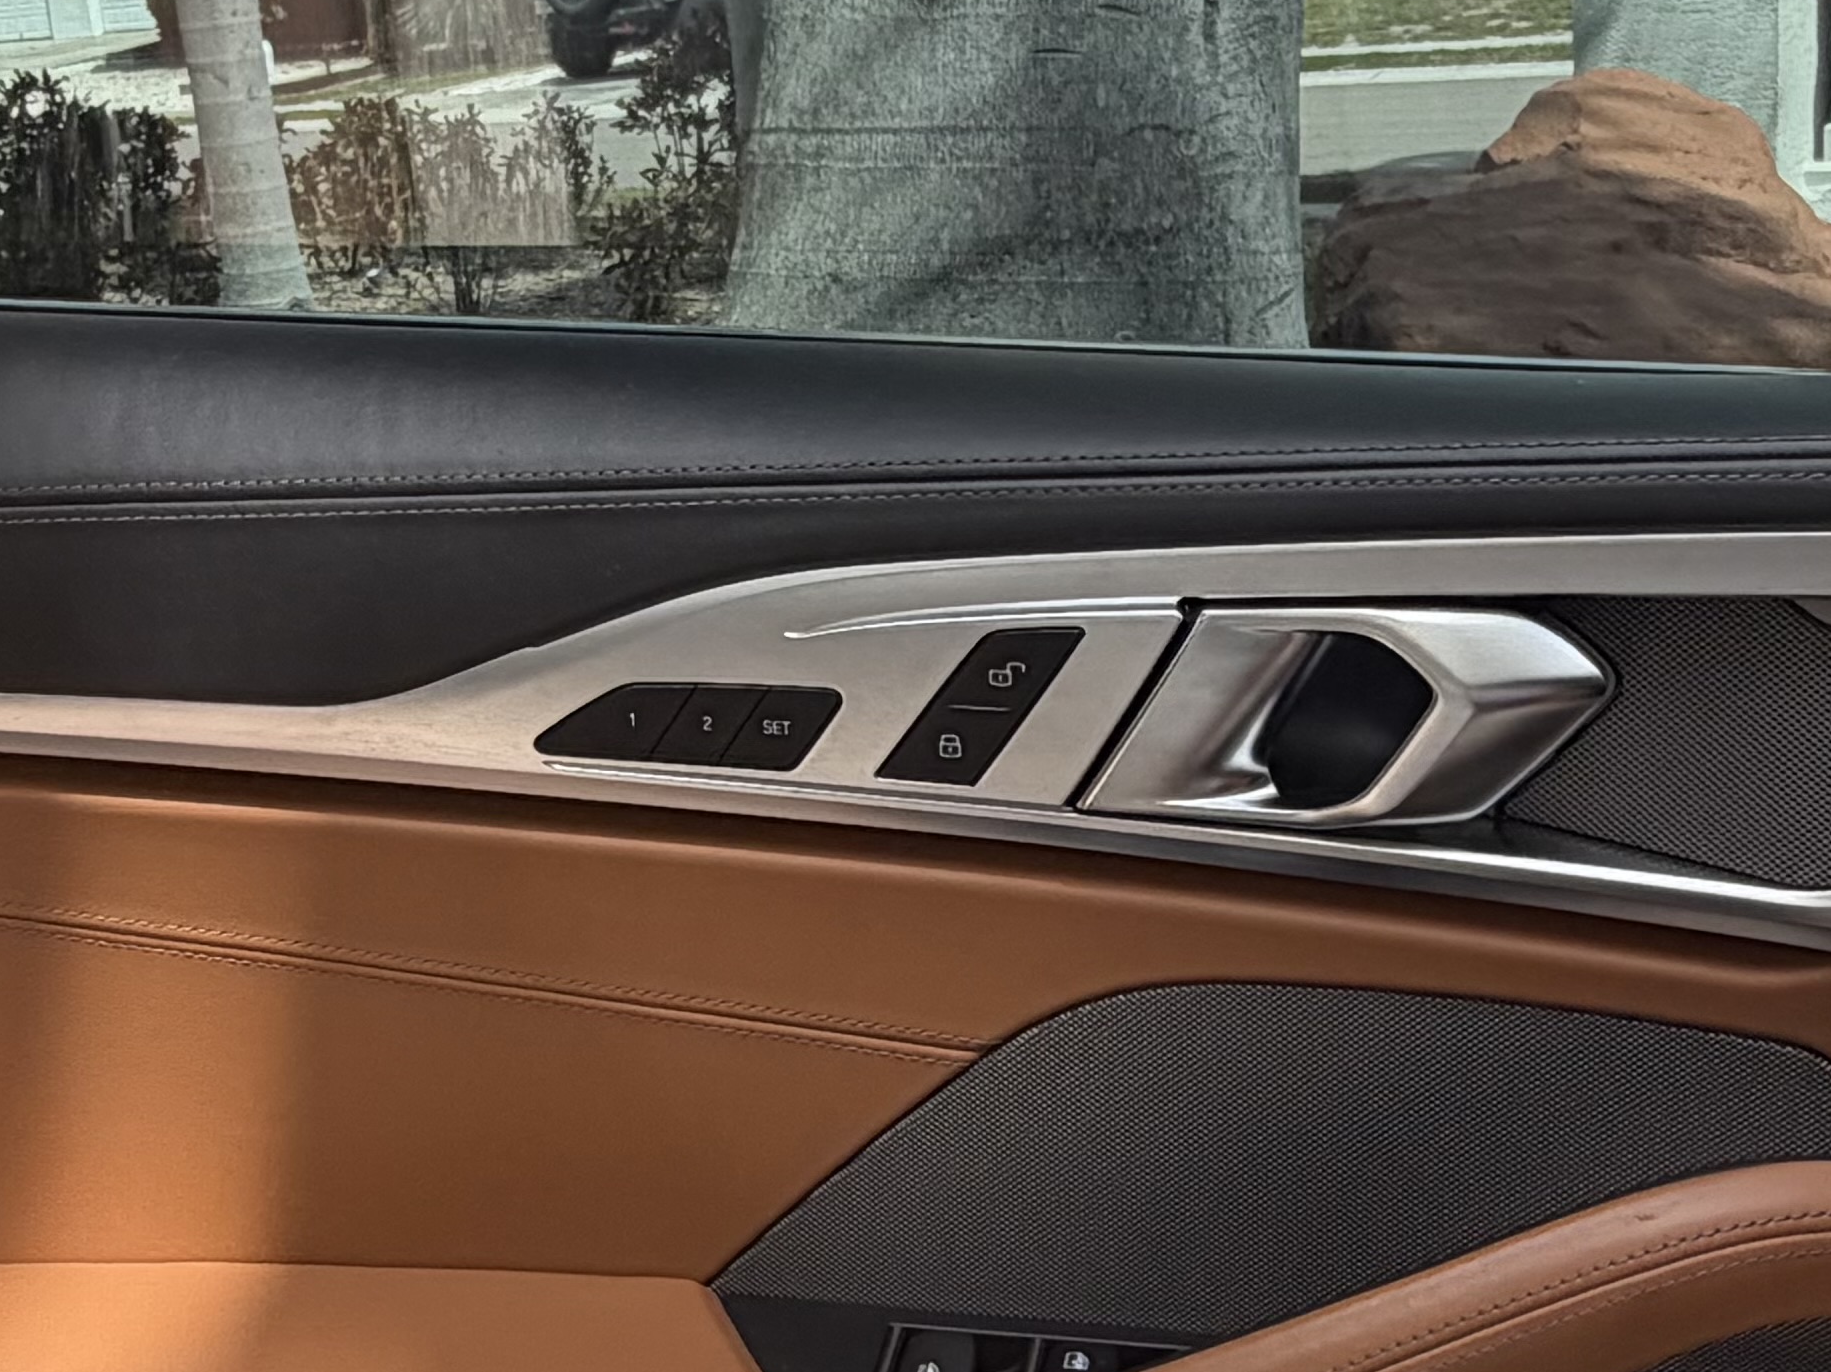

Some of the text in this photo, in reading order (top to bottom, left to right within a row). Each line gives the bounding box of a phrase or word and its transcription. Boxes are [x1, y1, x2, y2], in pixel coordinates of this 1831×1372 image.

[629, 712, 637, 728] 1
[702, 715, 713, 732] 2
[762, 719, 792, 736] SET
